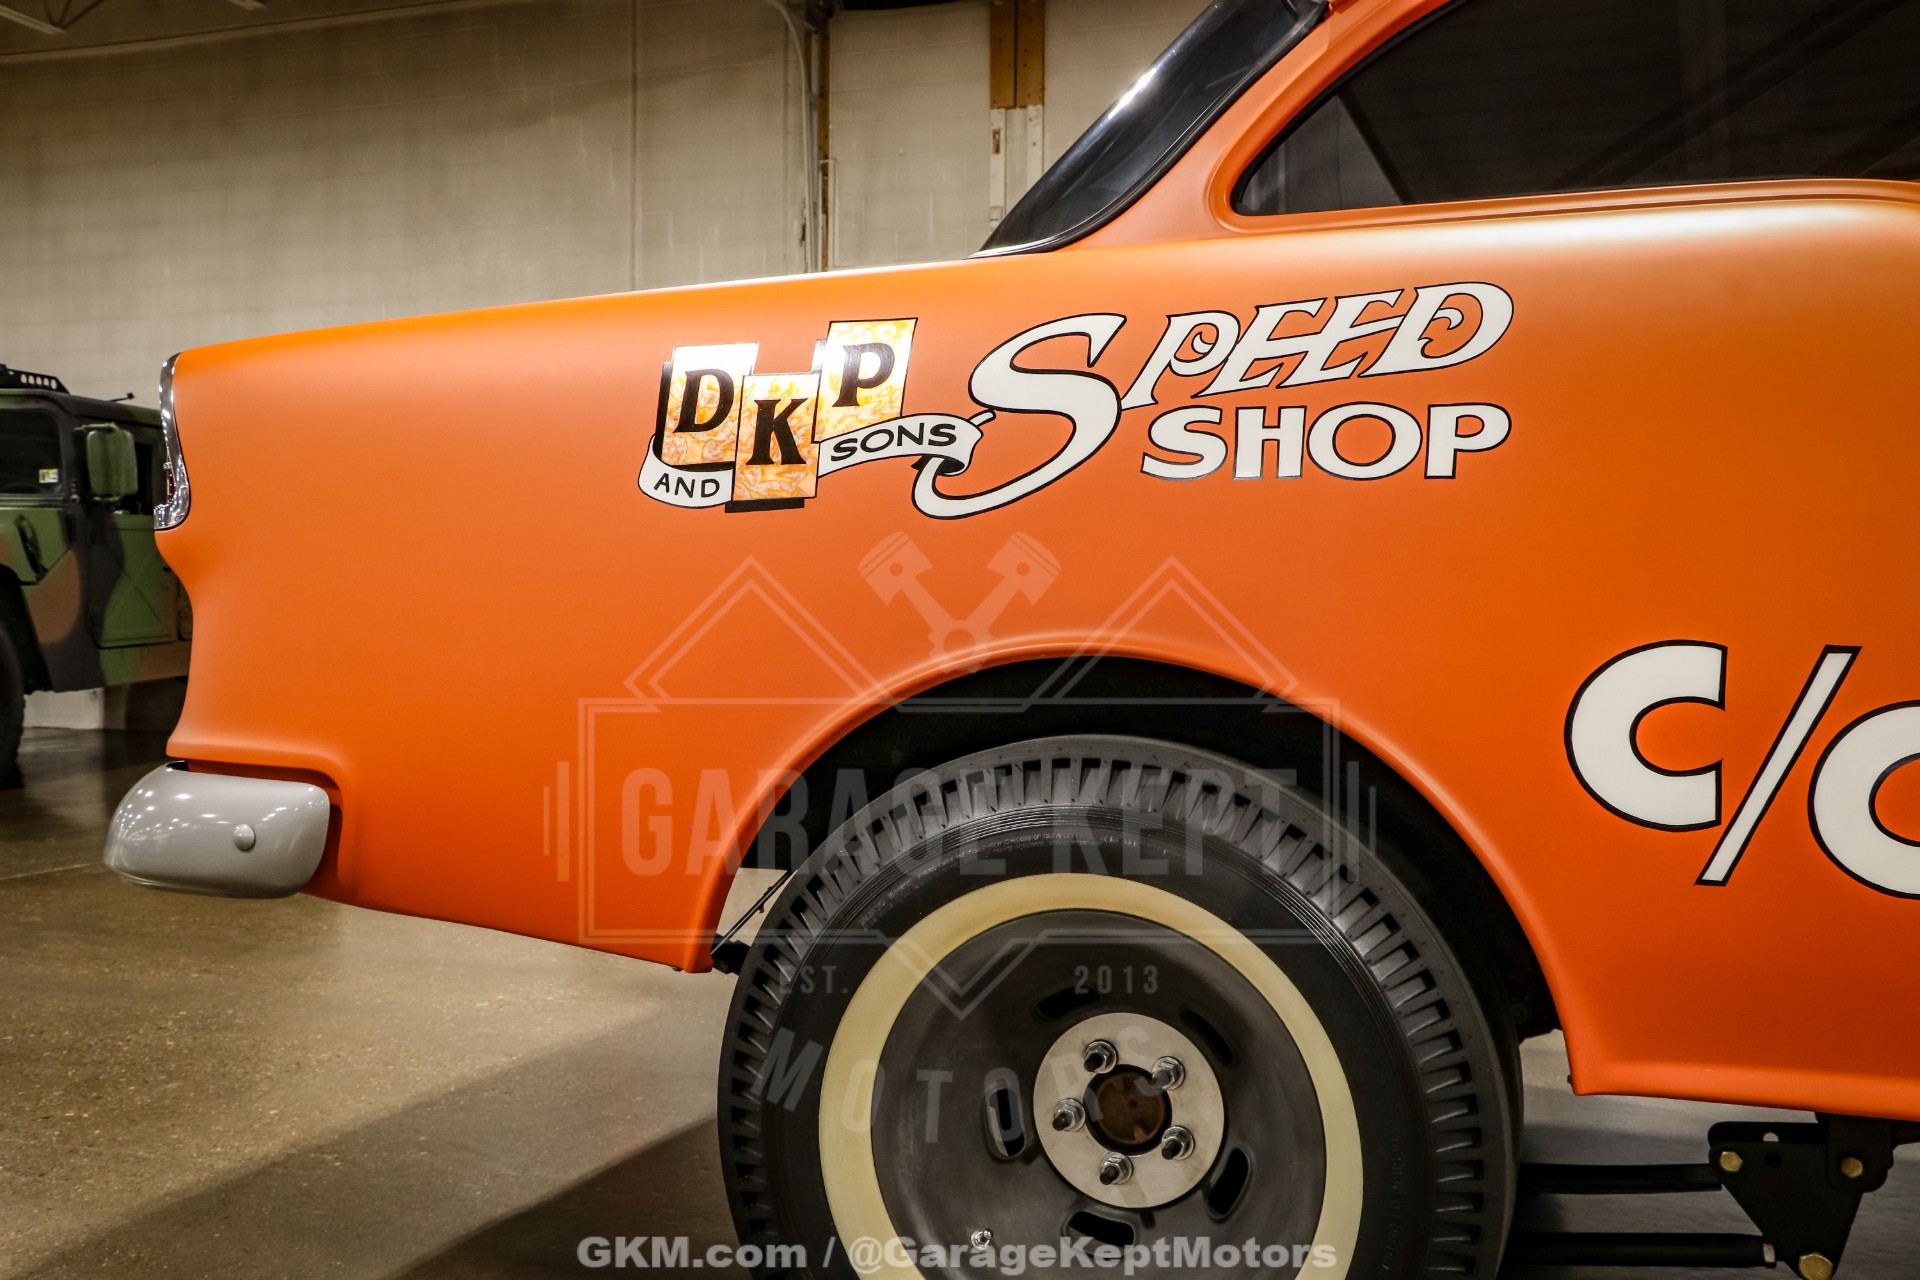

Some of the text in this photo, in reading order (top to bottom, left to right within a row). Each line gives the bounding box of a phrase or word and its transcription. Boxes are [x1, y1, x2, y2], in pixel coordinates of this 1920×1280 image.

[912, 282, 1514, 519] SPEED
[653, 423, 957, 498] AND SONS
[1140, 401, 1512, 482] SHOP
